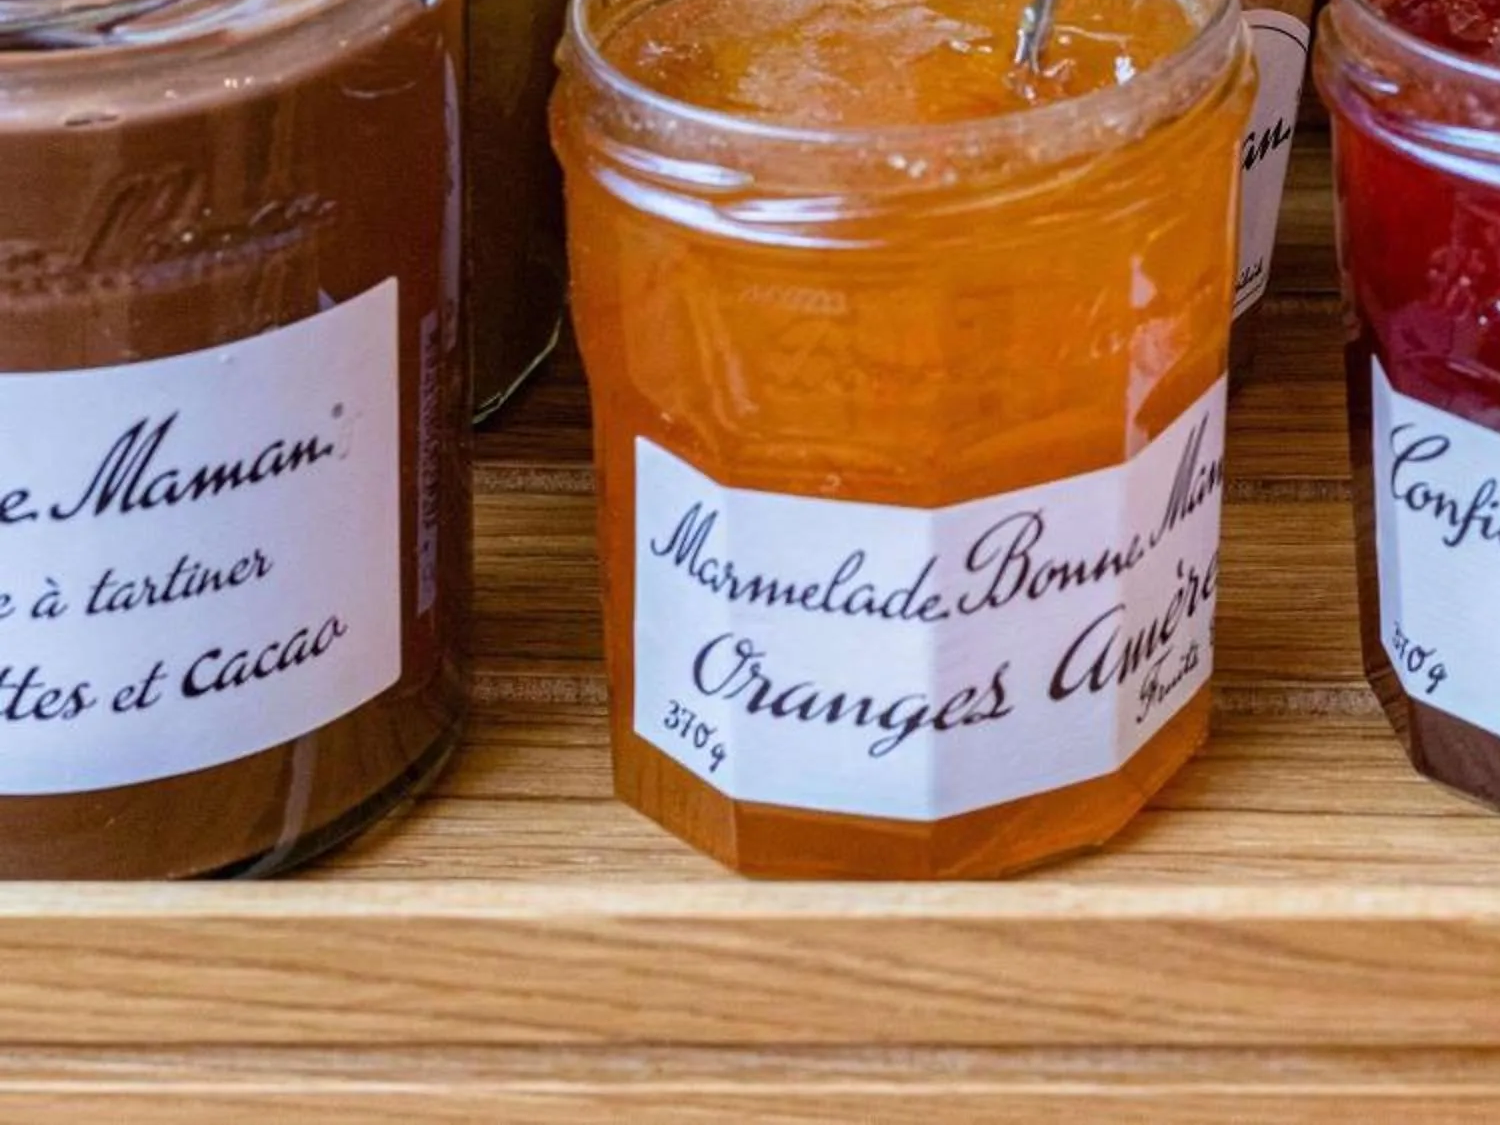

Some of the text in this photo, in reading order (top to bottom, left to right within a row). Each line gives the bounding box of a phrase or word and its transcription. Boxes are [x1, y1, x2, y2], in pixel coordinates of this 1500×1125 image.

[49, 412, 334, 521] Maman
[30, 576, 69, 619] à
[85, 546, 273, 617] tartiner
[650, 502, 952, 623] Marmelade
[959, 506, 1143, 615] Bonne
[112, 660, 166, 714] et
[180, 614, 348, 699] Cacao
[692, 632, 1015, 757] Oranges
